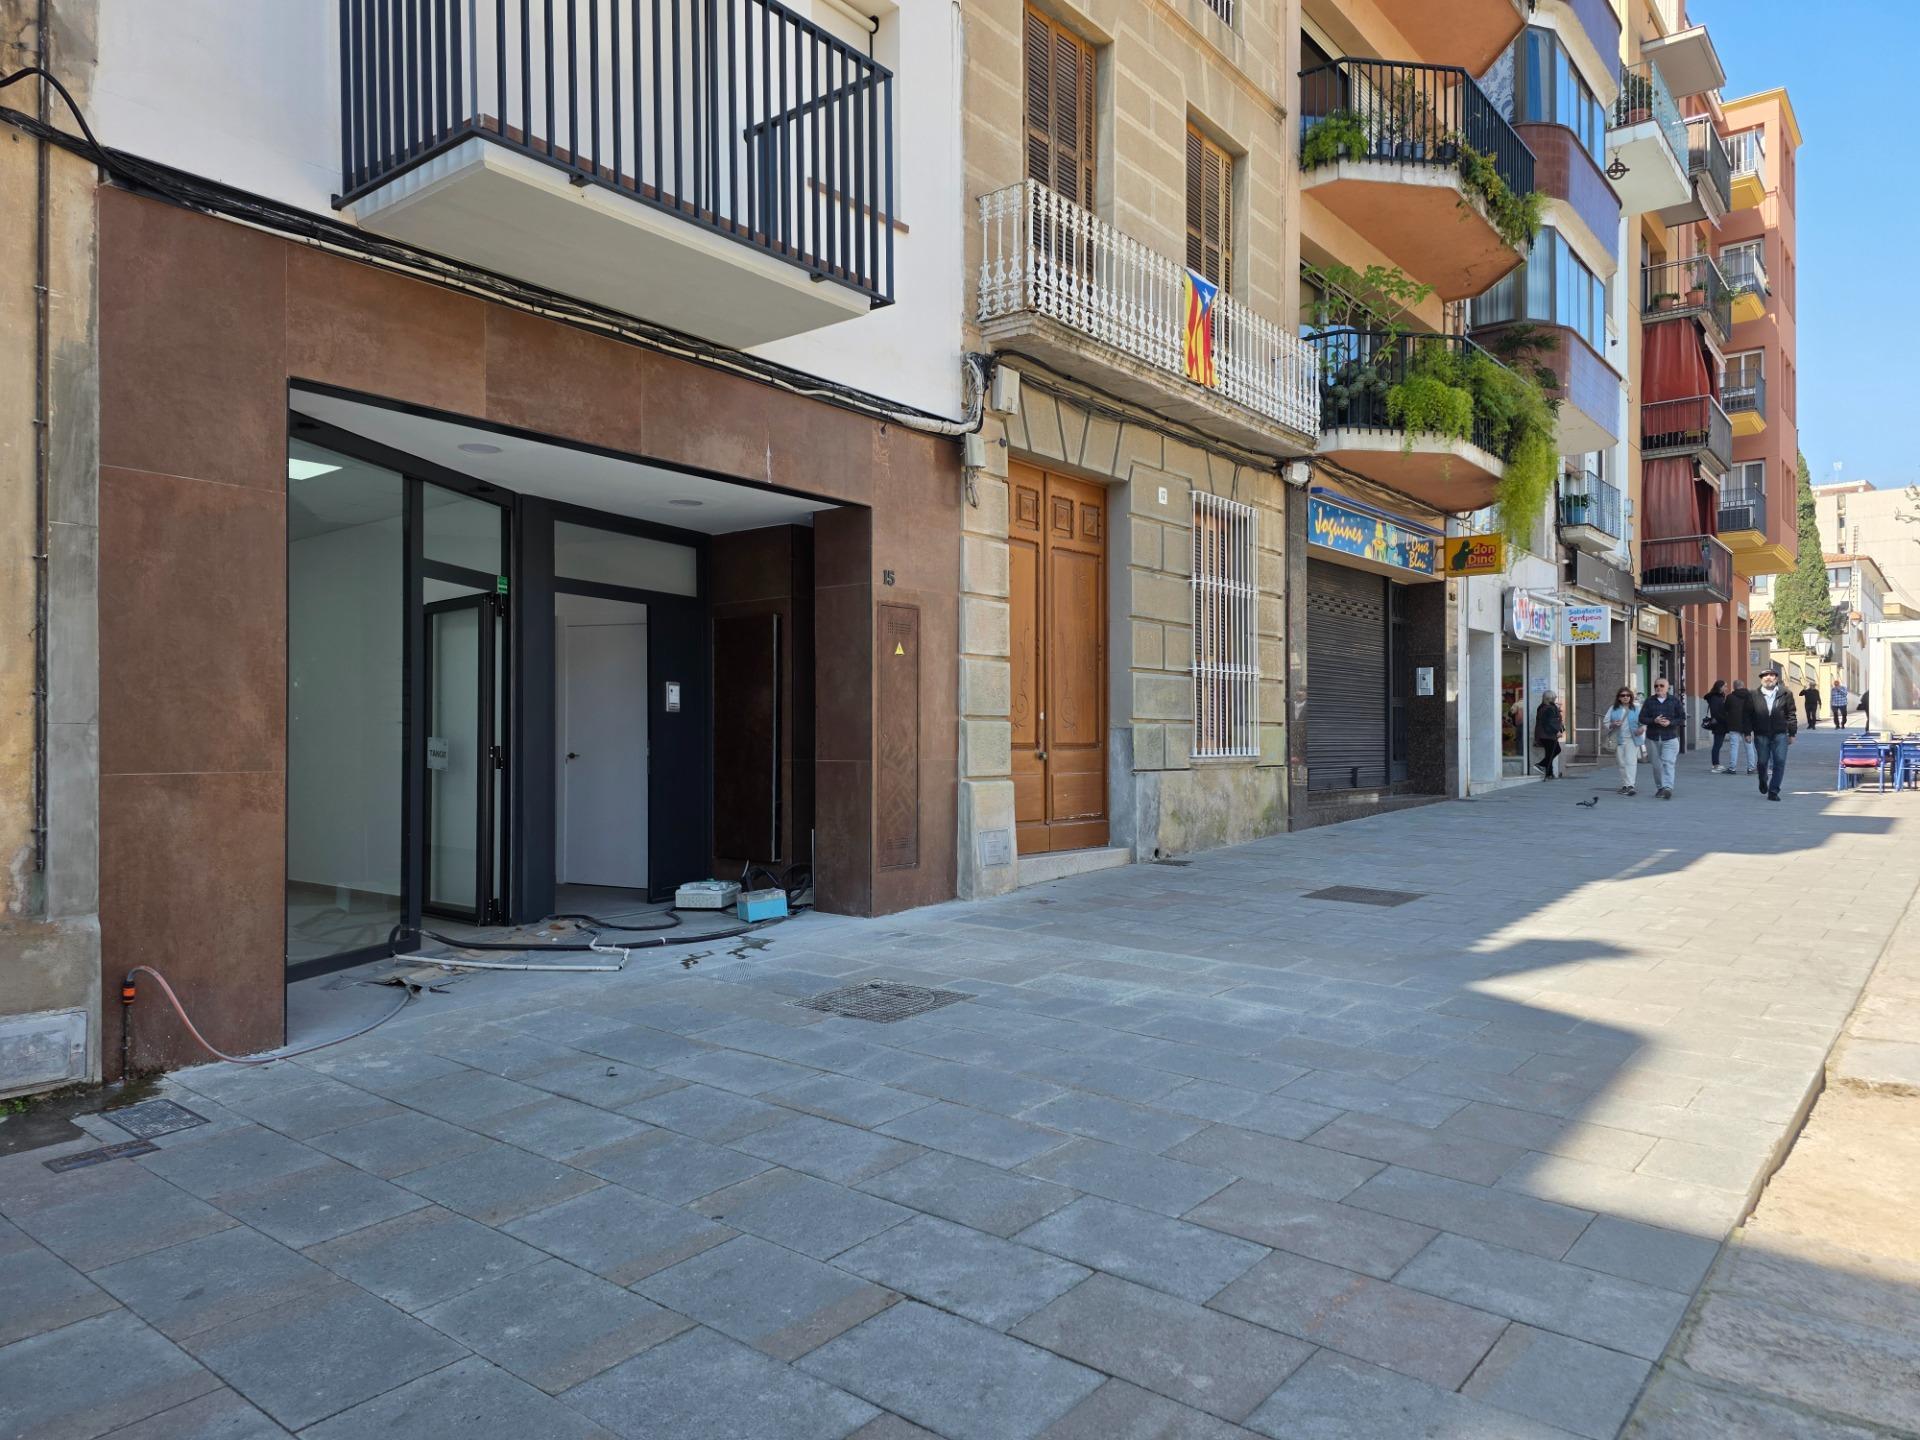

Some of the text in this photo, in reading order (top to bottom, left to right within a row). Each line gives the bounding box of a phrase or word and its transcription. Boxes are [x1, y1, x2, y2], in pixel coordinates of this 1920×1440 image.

[1315, 506, 1363, 546] Joguines
[1473, 542, 1496, 554] don
[1468, 554, 1496, 565] Dino
[883, 569, 895, 586] 15
